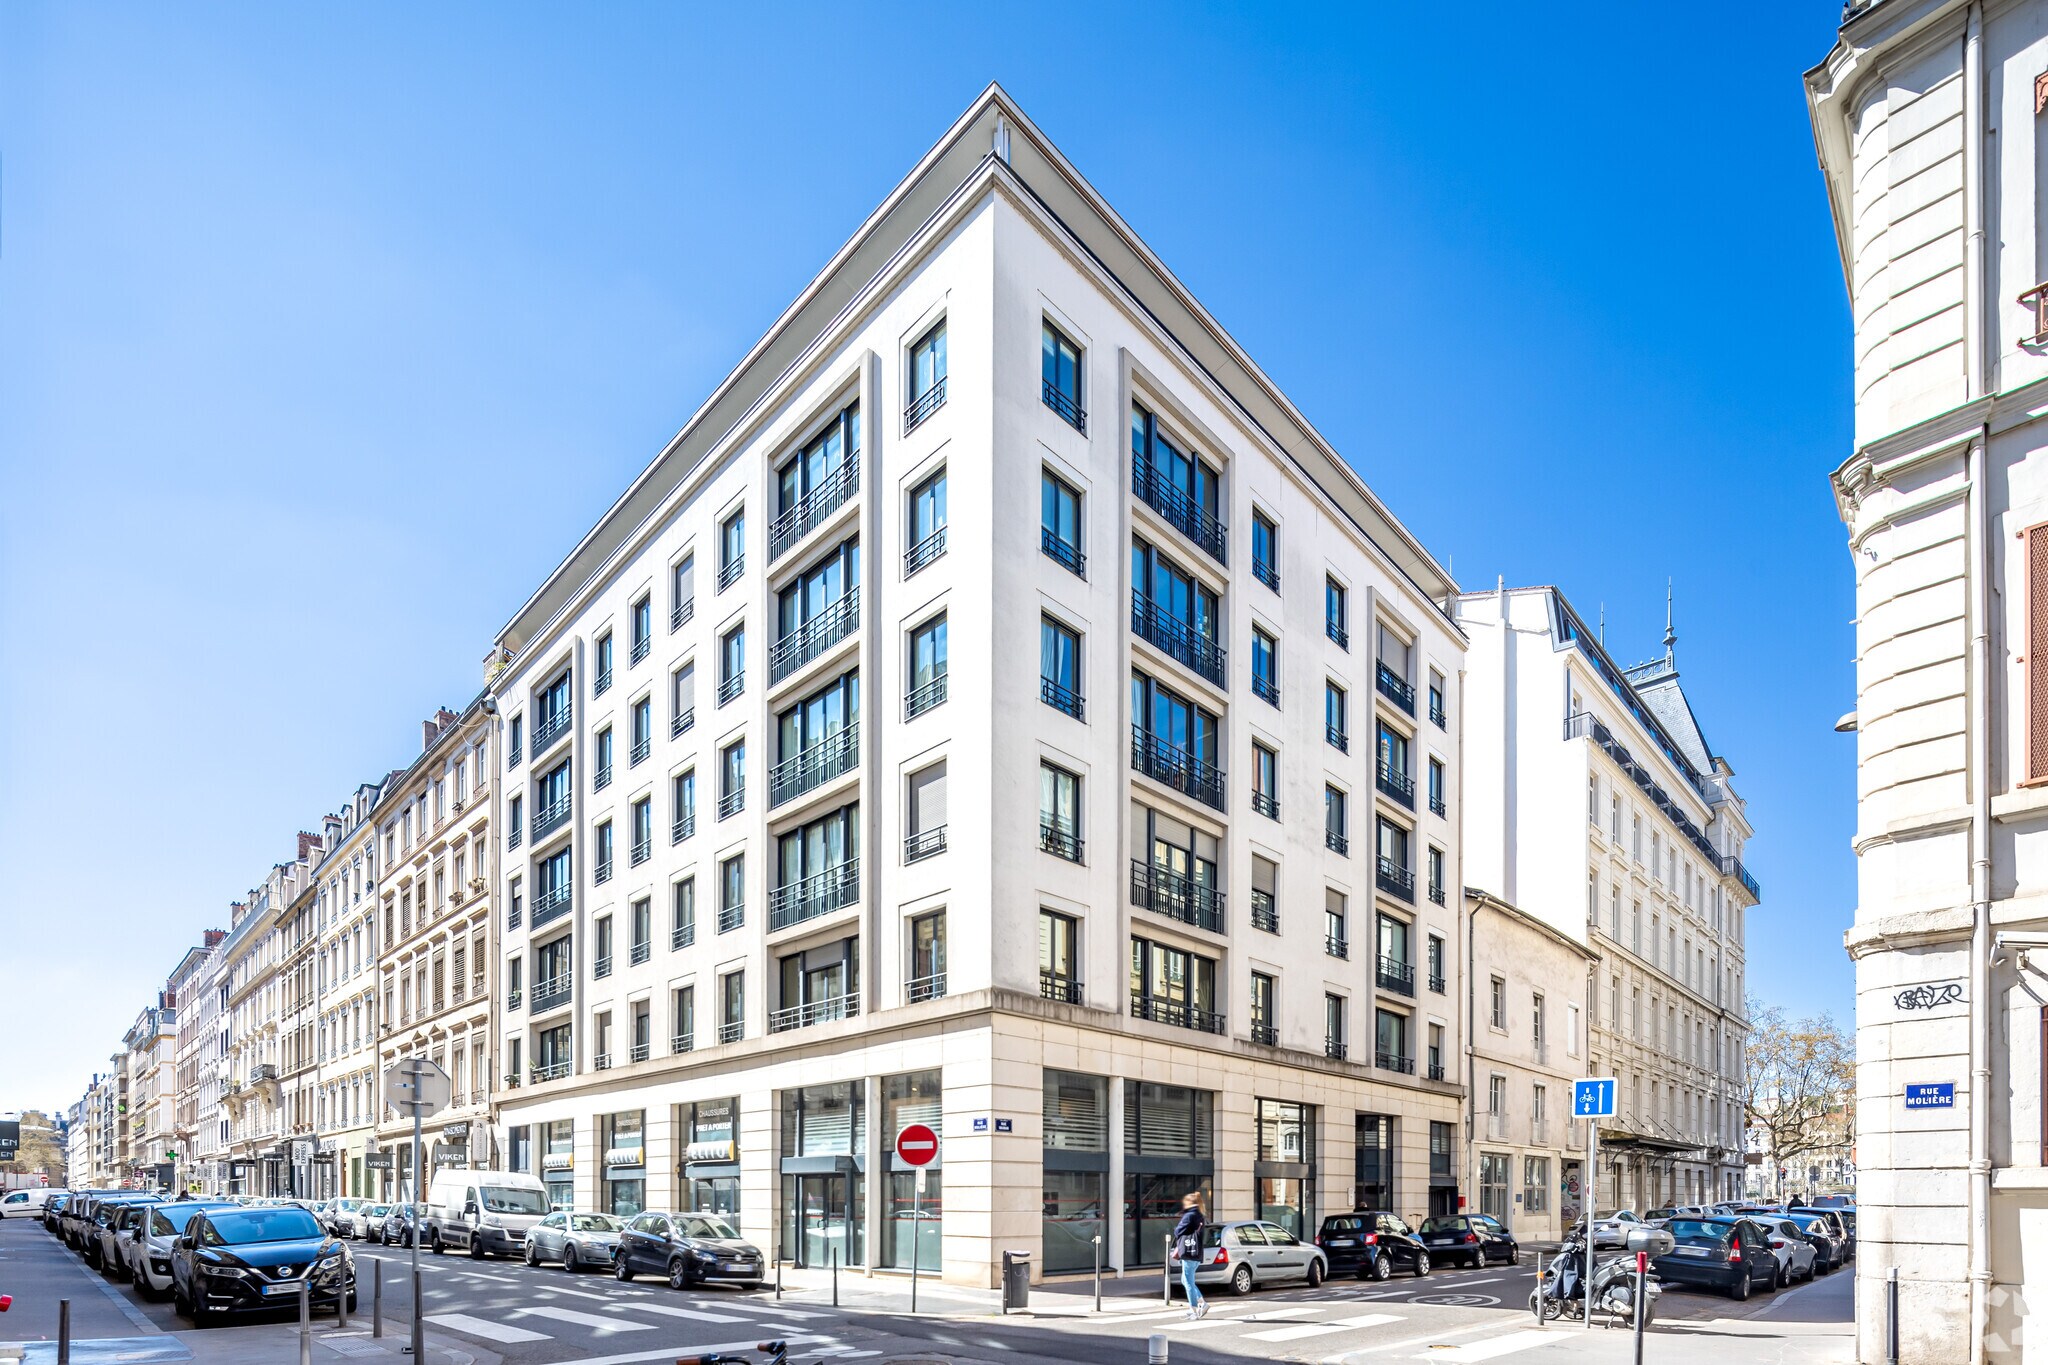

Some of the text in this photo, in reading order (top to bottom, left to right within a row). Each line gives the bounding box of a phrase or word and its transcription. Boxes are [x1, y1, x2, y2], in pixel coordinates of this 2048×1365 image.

[1919, 1087, 1939, 1095] RUE
[1907, 1095, 1952, 1105] MOLIÈRE
[0, 1138, 18, 1146] EN
[438, 1153, 465, 1161] VIKEN
